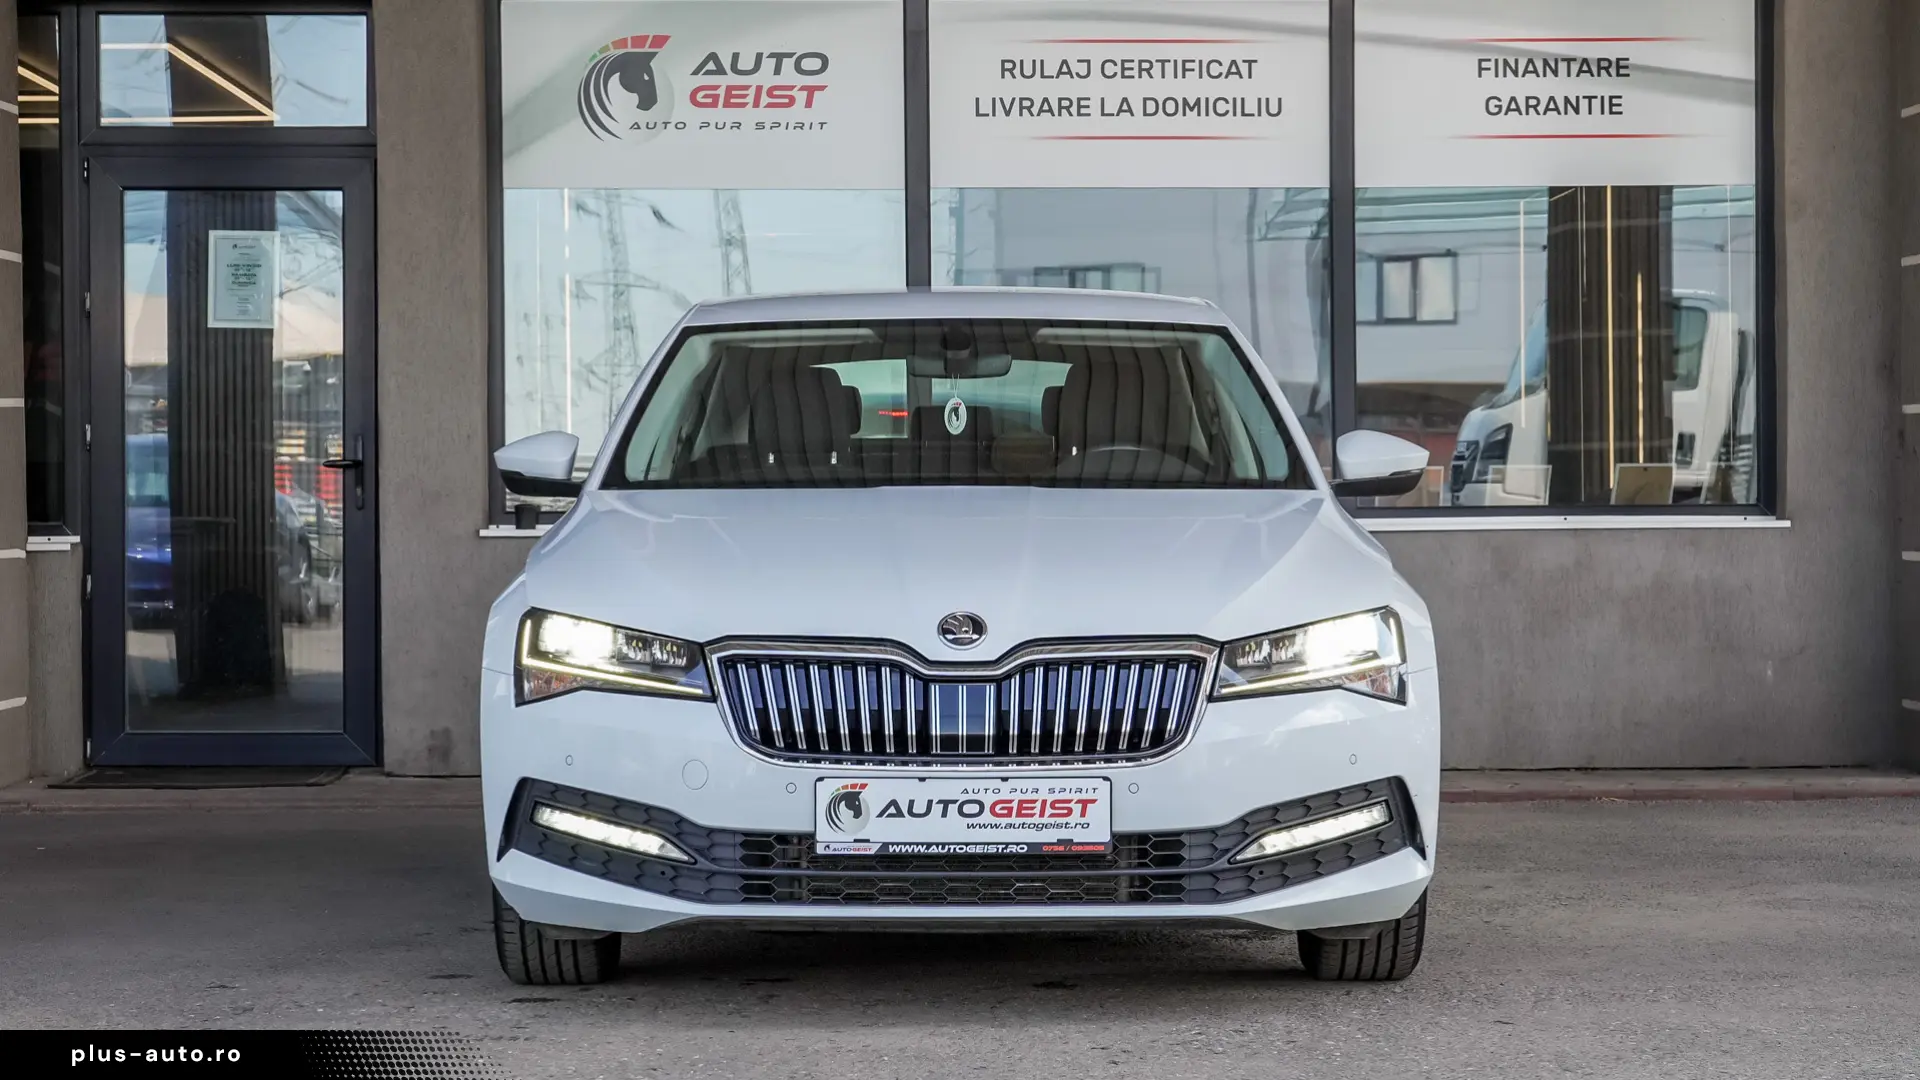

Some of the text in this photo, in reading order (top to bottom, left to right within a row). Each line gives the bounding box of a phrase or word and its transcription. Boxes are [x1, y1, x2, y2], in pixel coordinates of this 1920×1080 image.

[689, 51, 830, 76] AUTO
[1000, 59, 1258, 80] RULAJ CERTIFICAT
[1477, 57, 1631, 78] FINANTARE
[689, 84, 829, 109] GEIST
[975, 96, 1283, 118] LIVRARE LA DOMICILIU
[1484, 95, 1624, 116] GARANTIE
[628, 121, 829, 131] AUTO PUR SPIRIT
[960, 787, 1099, 795] AUTO PUR SPIRIT
[875, 798, 1098, 819] AUTOGEIST
[966, 820, 1091, 832] www.autogeist.ro
[888, 843, 1028, 854] WWW.AUTOGEIST.RO
